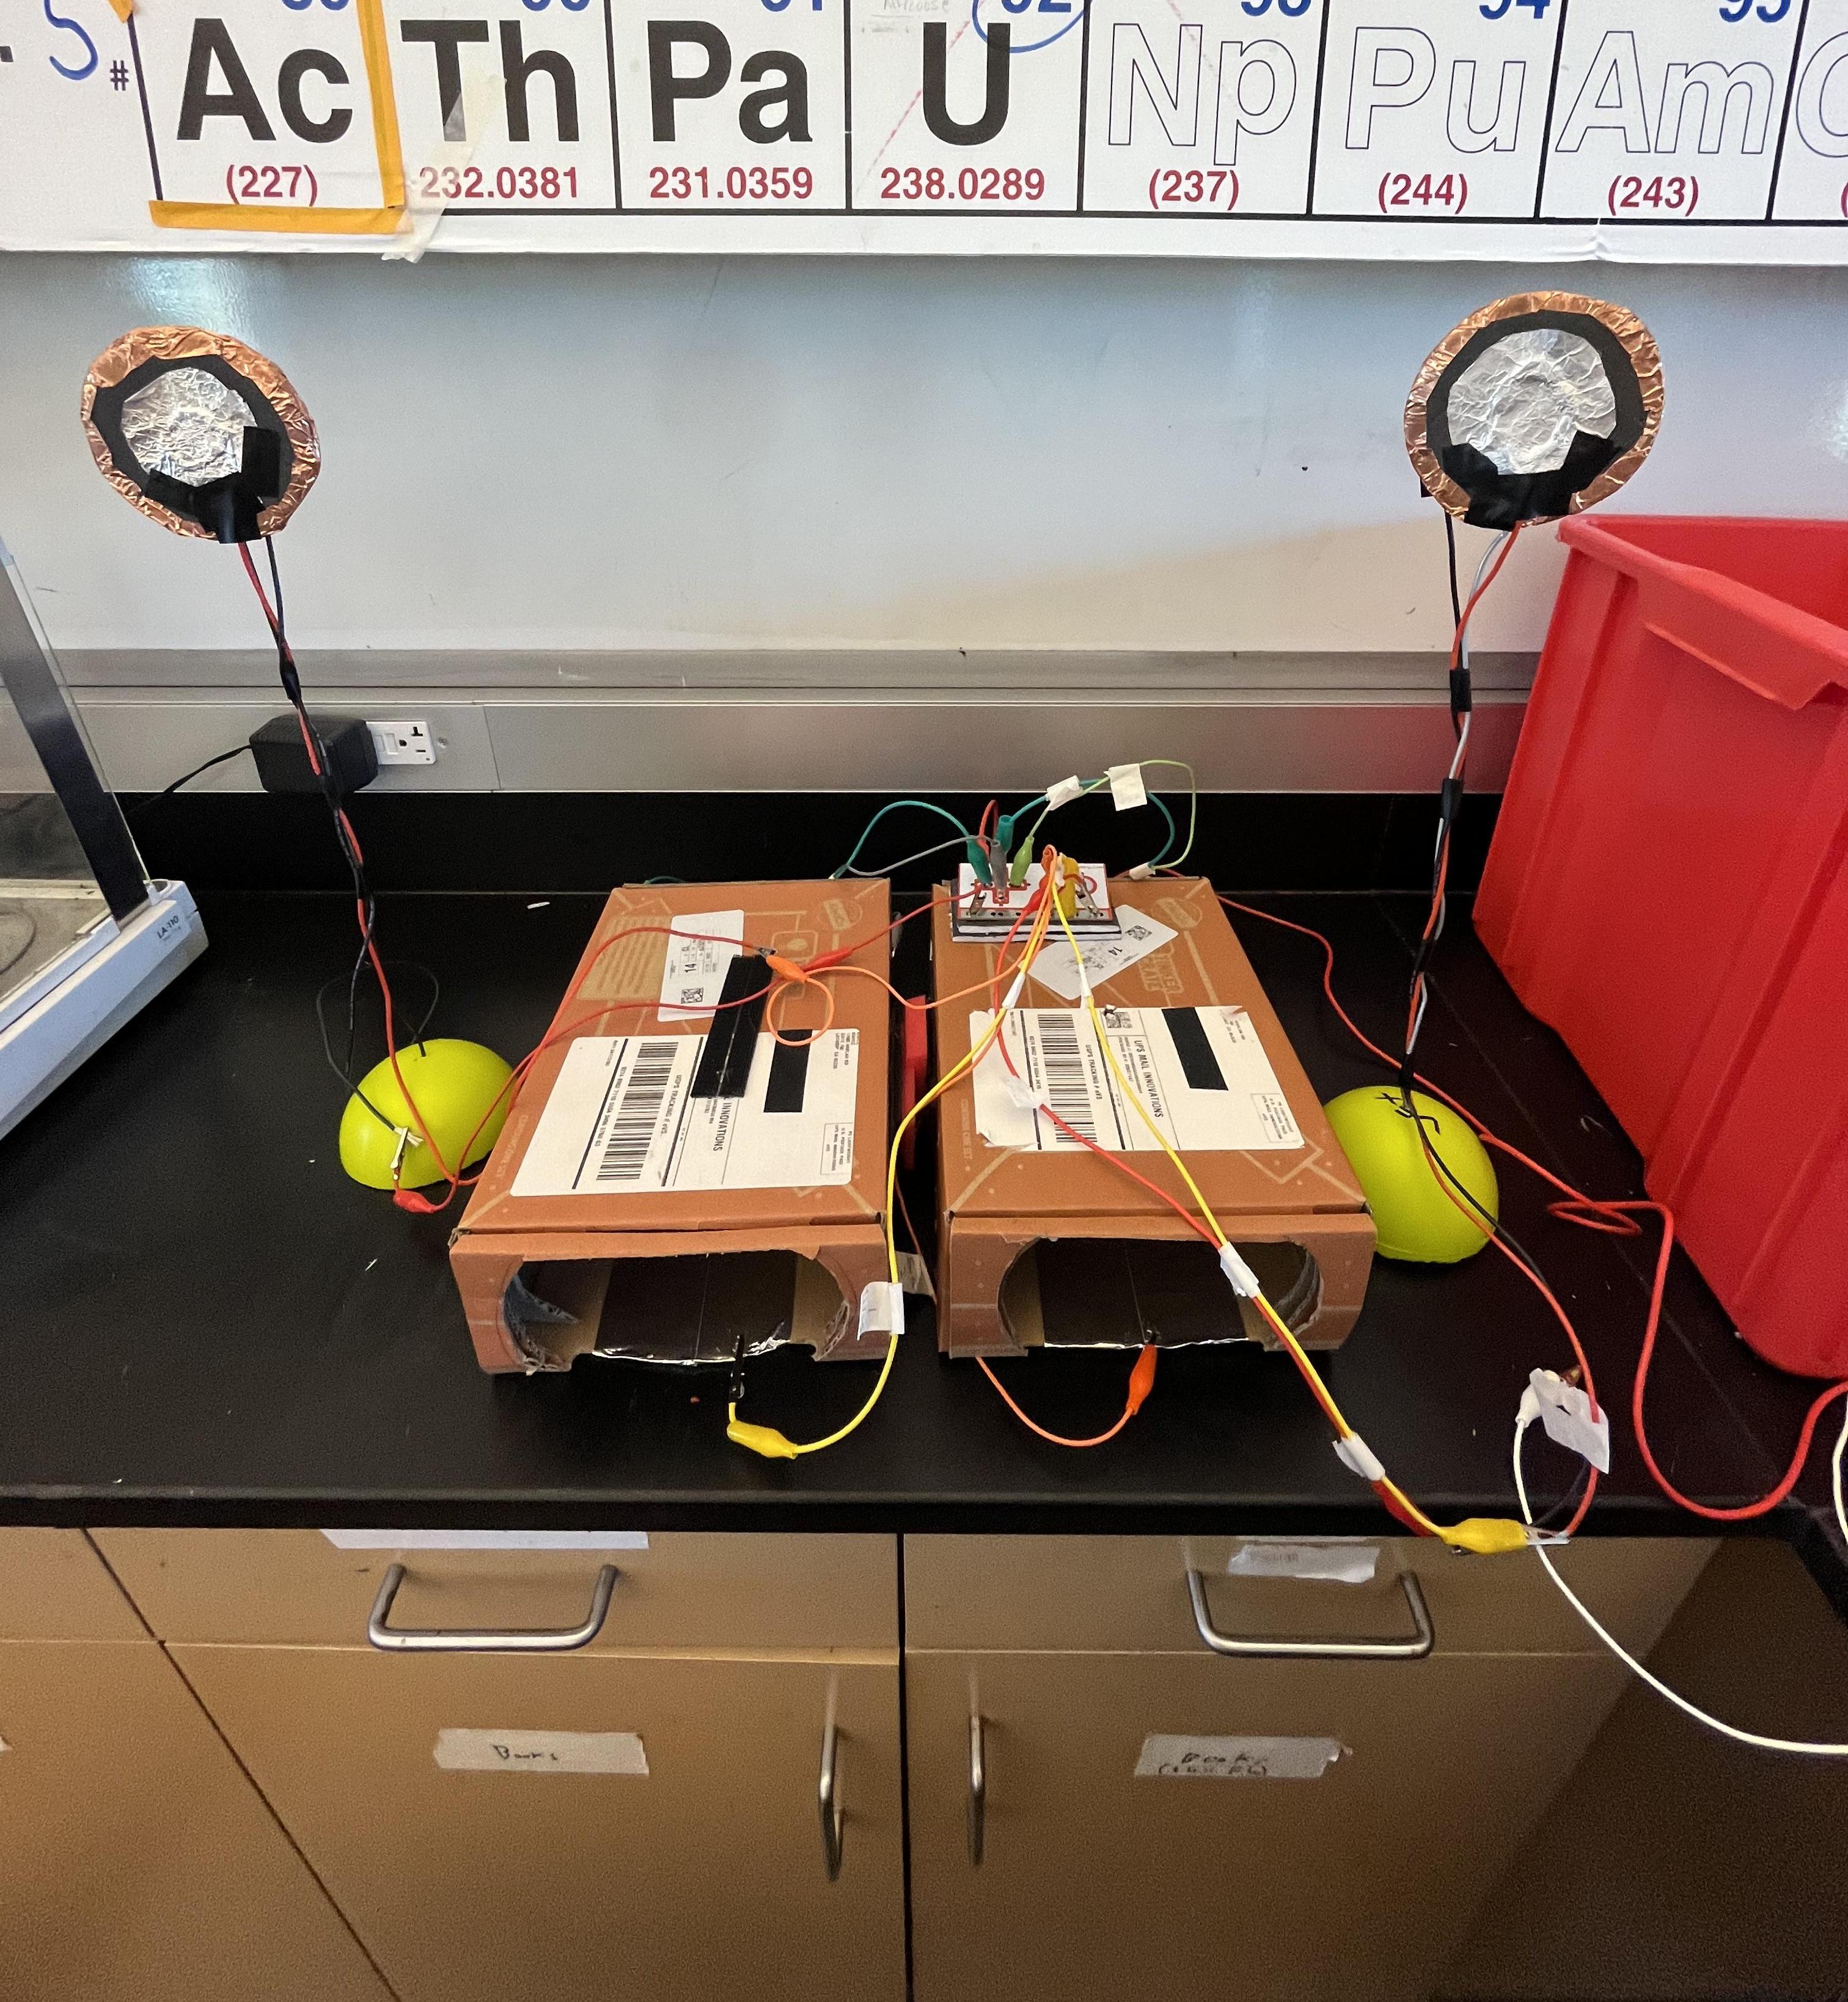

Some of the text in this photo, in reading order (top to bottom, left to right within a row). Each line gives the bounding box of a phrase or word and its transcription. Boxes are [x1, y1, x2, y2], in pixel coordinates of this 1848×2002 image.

[177, 18, 353, 144] Ac
[400, 19, 579, 142] Th
[647, 21, 813, 144] Pa
[923, 22, 1011, 146] U
[1107, 23, 1297, 166] Np
[1344, 27, 1527, 153] Pu
[1555, 31, 1775, 154] Am
[226, 165, 317, 207] (227)
[419, 166, 578, 199] 232.0381
[649, 166, 813, 199] 231.0359
[881, 167, 1044, 200] 238.0289
[1148, 169, 1239, 210] (237)
[1378, 173, 1468, 214] (244)
[1607, 175, 1699, 216] (243)
[1084, 1044, 1094, 1057] USPS
[1133, 1040, 1145, 1052] UPS
[1137, 1054, 1150, 1069] MAIL
[672, 1074, 683, 1088] USPS
[1087, 1059, 1100, 1084] TRACKING
[664, 1090, 678, 1116] TRACKING
[1141, 1072, 1165, 1117] INNOVATIONS
[713, 1102, 732, 1151] INNOVATIONS
